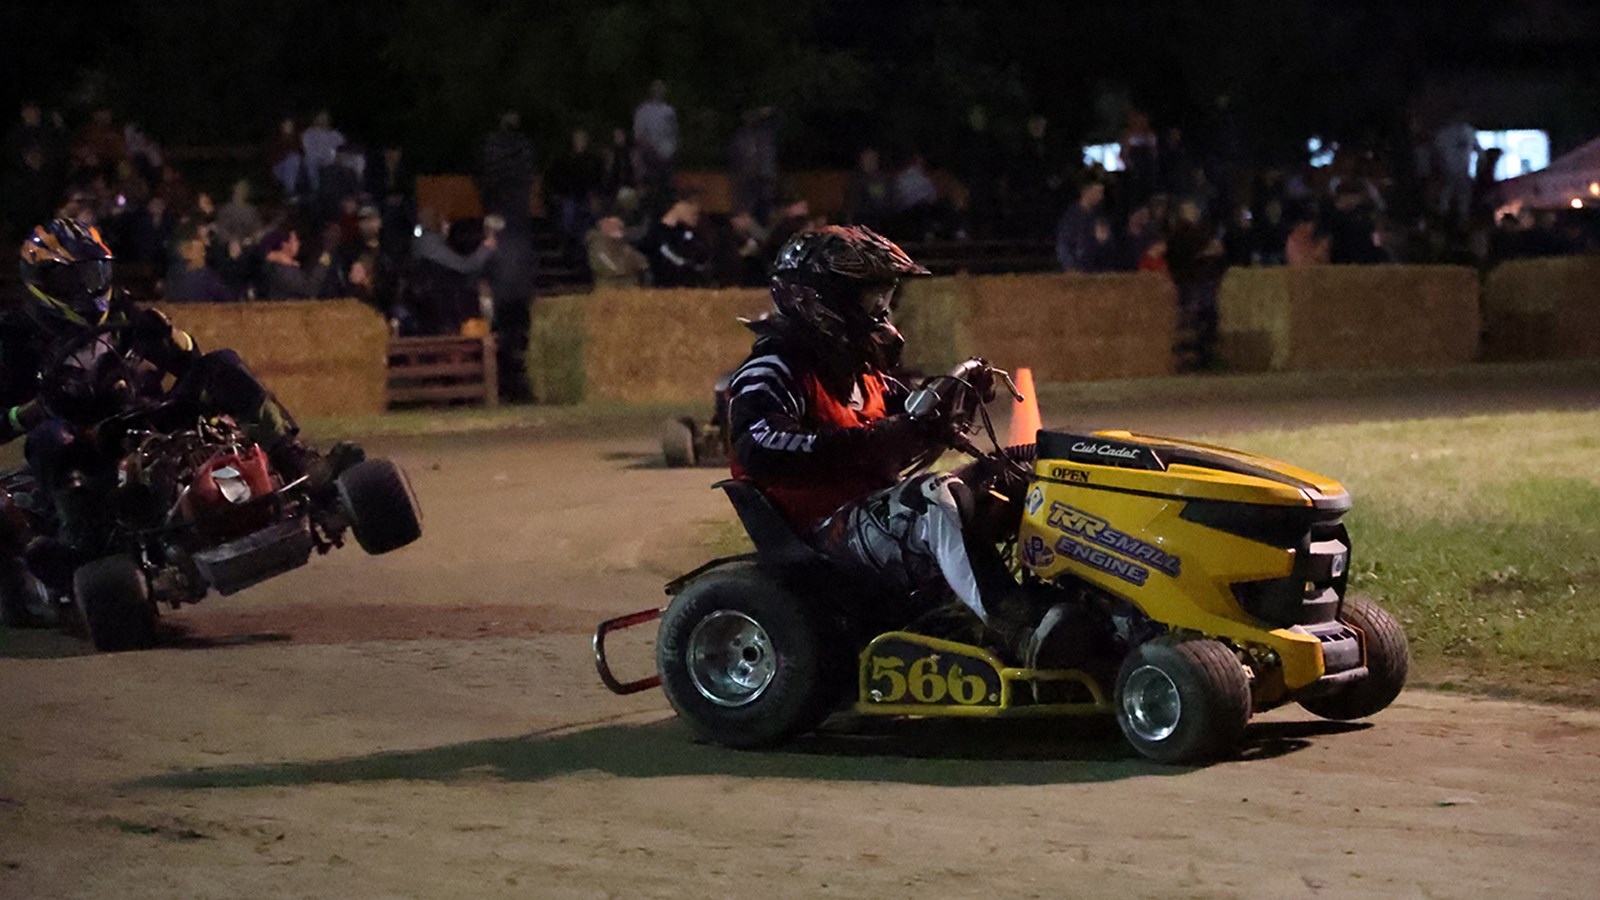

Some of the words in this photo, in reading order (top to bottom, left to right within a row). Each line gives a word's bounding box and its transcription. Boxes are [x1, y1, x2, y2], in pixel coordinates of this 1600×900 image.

[1071, 442, 1097, 454] Cub
[1097, 444, 1141, 459] Cadet
[1052, 467, 1090, 482] OPEN
[1057, 537, 1149, 584] ENGINE
[1100, 528, 1181, 575] SMALL
[872, 656, 987, 705] 566
